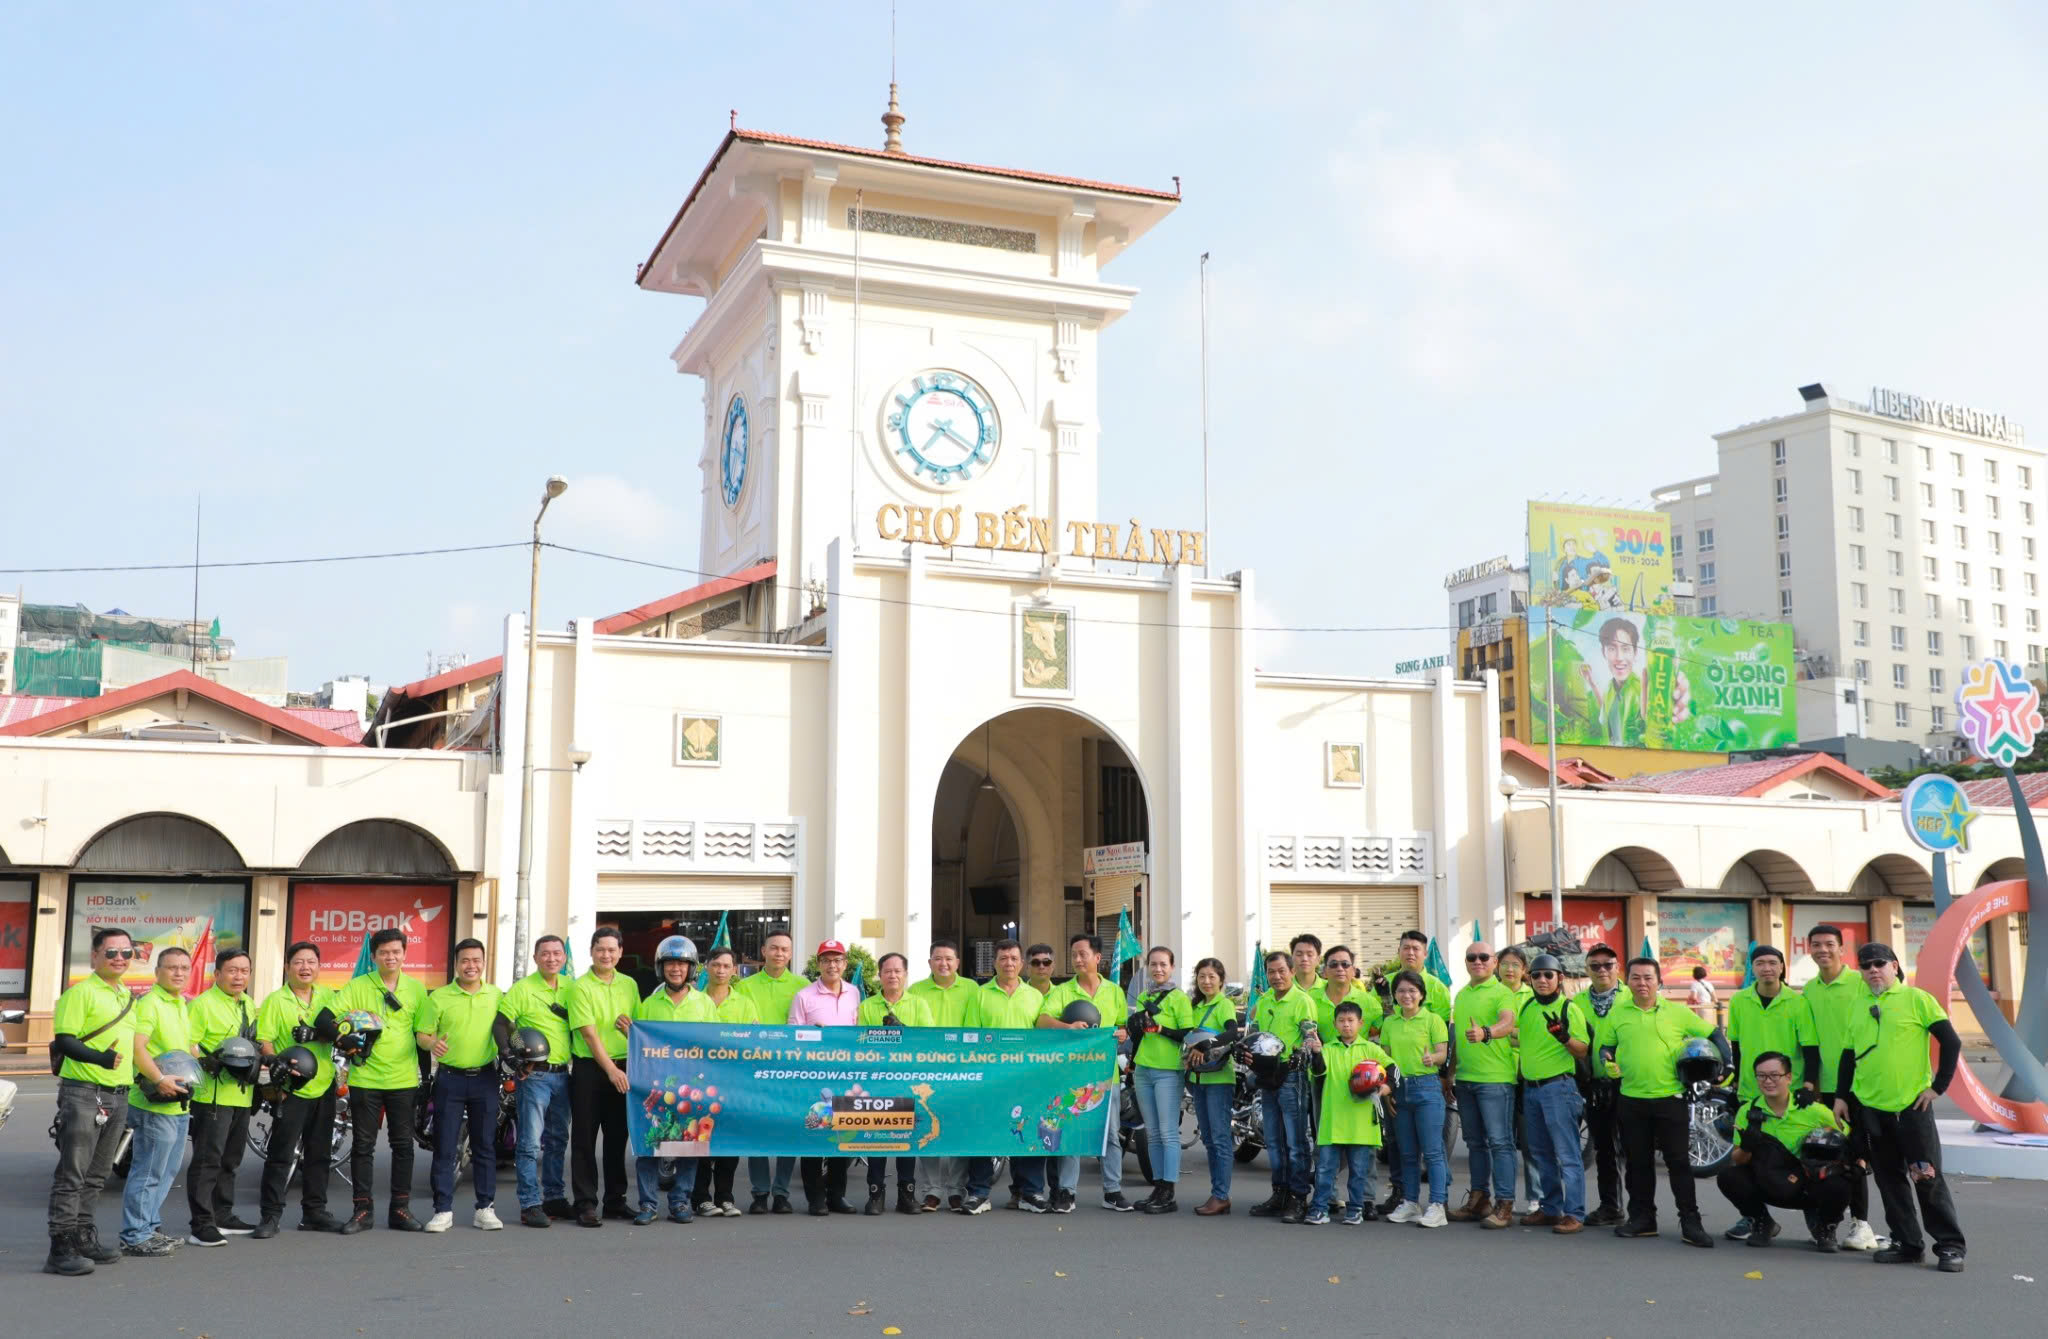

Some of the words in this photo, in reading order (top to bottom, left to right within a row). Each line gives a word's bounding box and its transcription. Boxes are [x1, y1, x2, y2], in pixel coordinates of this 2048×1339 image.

[876, 503, 962, 549] CHỢ
[975, 504, 1053, 554] BẾN
[1066, 517, 1206, 566] THÀNH
[1613, 527, 1665, 557] 30/4
[1395, 659, 1420, 674] SONG
[1422, 655, 1445, 671] ANH
[1727, 664, 1786, 686] LONG
[1712, 684, 1780, 708] XANH
[87, 896, 136, 906] HDBank
[309, 909, 414, 932] HDBank
[309, 934, 328, 943] Cam
[868, 1036, 901, 1044] CHANGE
[642, 1046, 671, 1058] THẾ
[673, 1046, 704, 1059] GIỚI
[707, 1047, 739, 1060] CÒN
[806, 1049, 851, 1062] NGƯỜI
[889, 1052, 912, 1063] XIN
[916, 1050, 957, 1063] ĐỪNG
[1000, 1051, 1024, 1063] PHÍ
[753, 1070, 868, 1081] #STOPFOODWASTE
[870, 1071, 984, 1082] #FOODFORCHANGE
[853, 1098, 894, 1111] STOP
[838, 1117, 870, 1126] FOOD
[873, 1117, 913, 1126] WASTE
